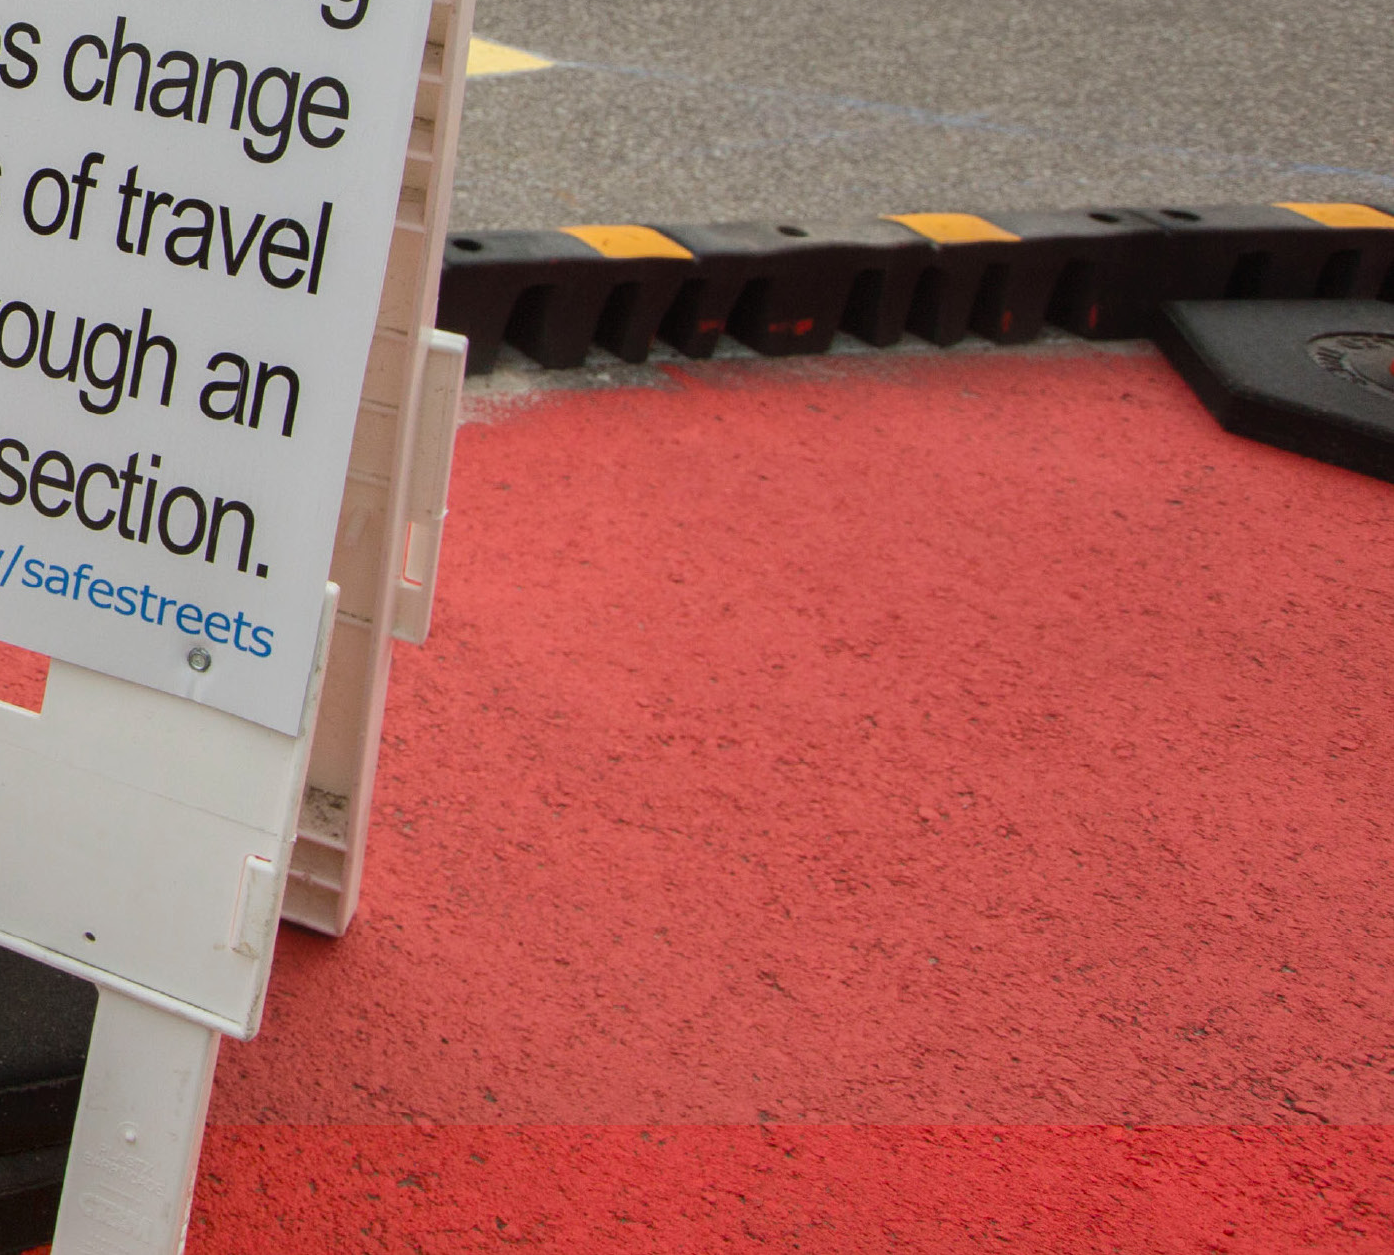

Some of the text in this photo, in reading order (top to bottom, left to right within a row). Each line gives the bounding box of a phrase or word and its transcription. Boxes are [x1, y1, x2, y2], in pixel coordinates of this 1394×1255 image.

[62, 14, 351, 165] change
[21, 150, 106, 242] of
[115, 163, 334, 296] travel
[198, 350, 301, 439] an
